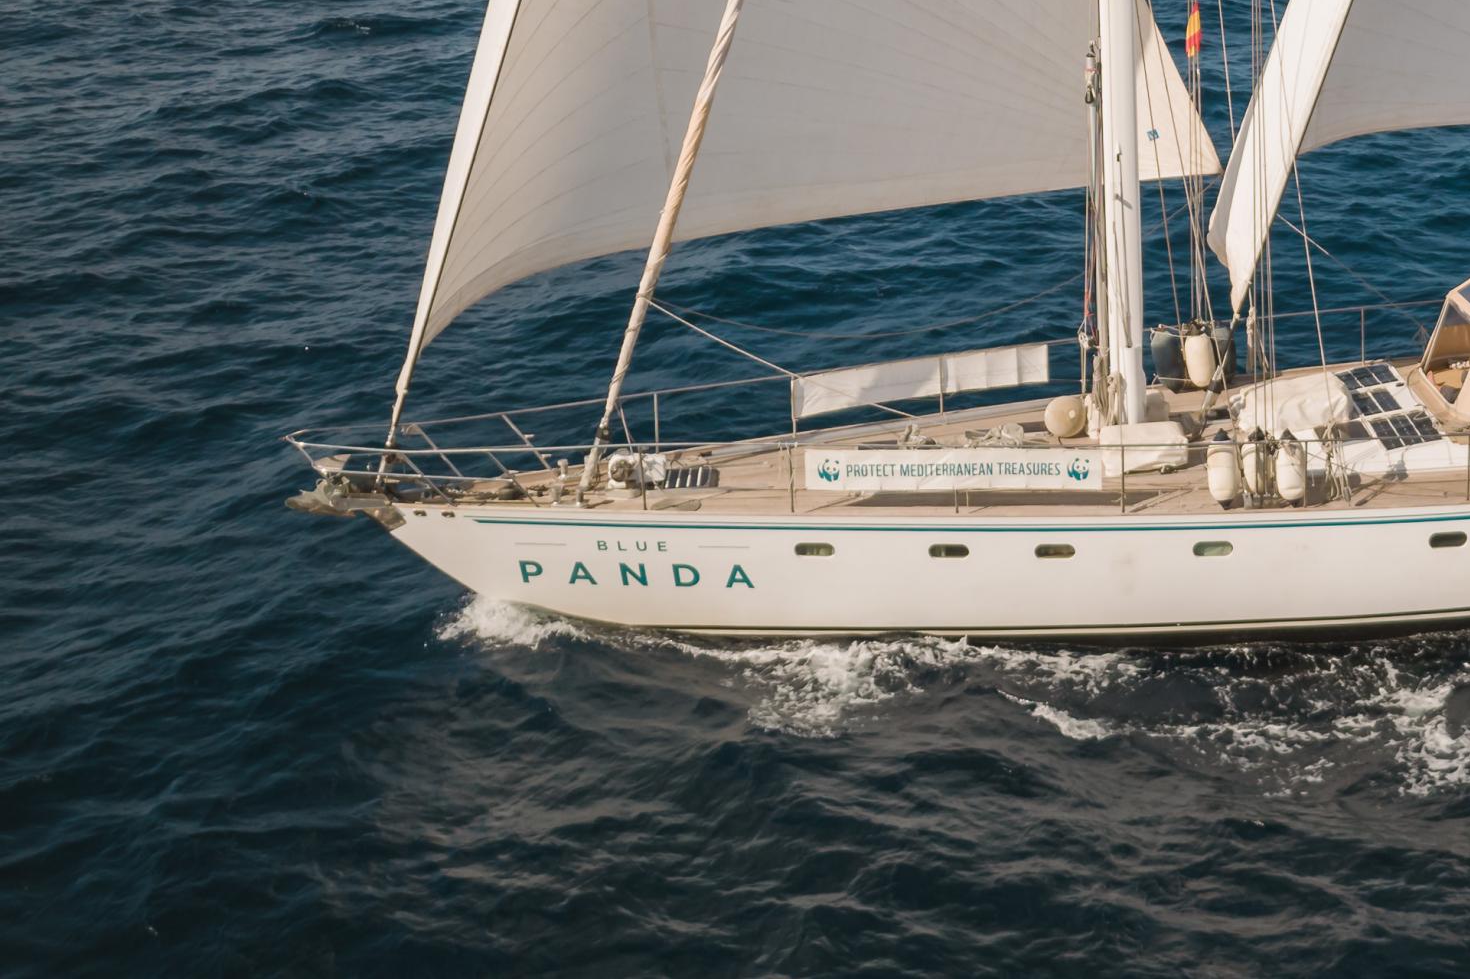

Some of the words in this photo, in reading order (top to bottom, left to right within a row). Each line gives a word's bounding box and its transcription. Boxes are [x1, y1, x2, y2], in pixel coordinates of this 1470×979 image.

[846, 463, 896, 477] PROTECT
[899, 461, 993, 477] MEDITERRANEAN
[998, 462, 1061, 475] TREASURES
[596, 540, 669, 552] BLUE
[518, 559, 755, 589] PANDA
